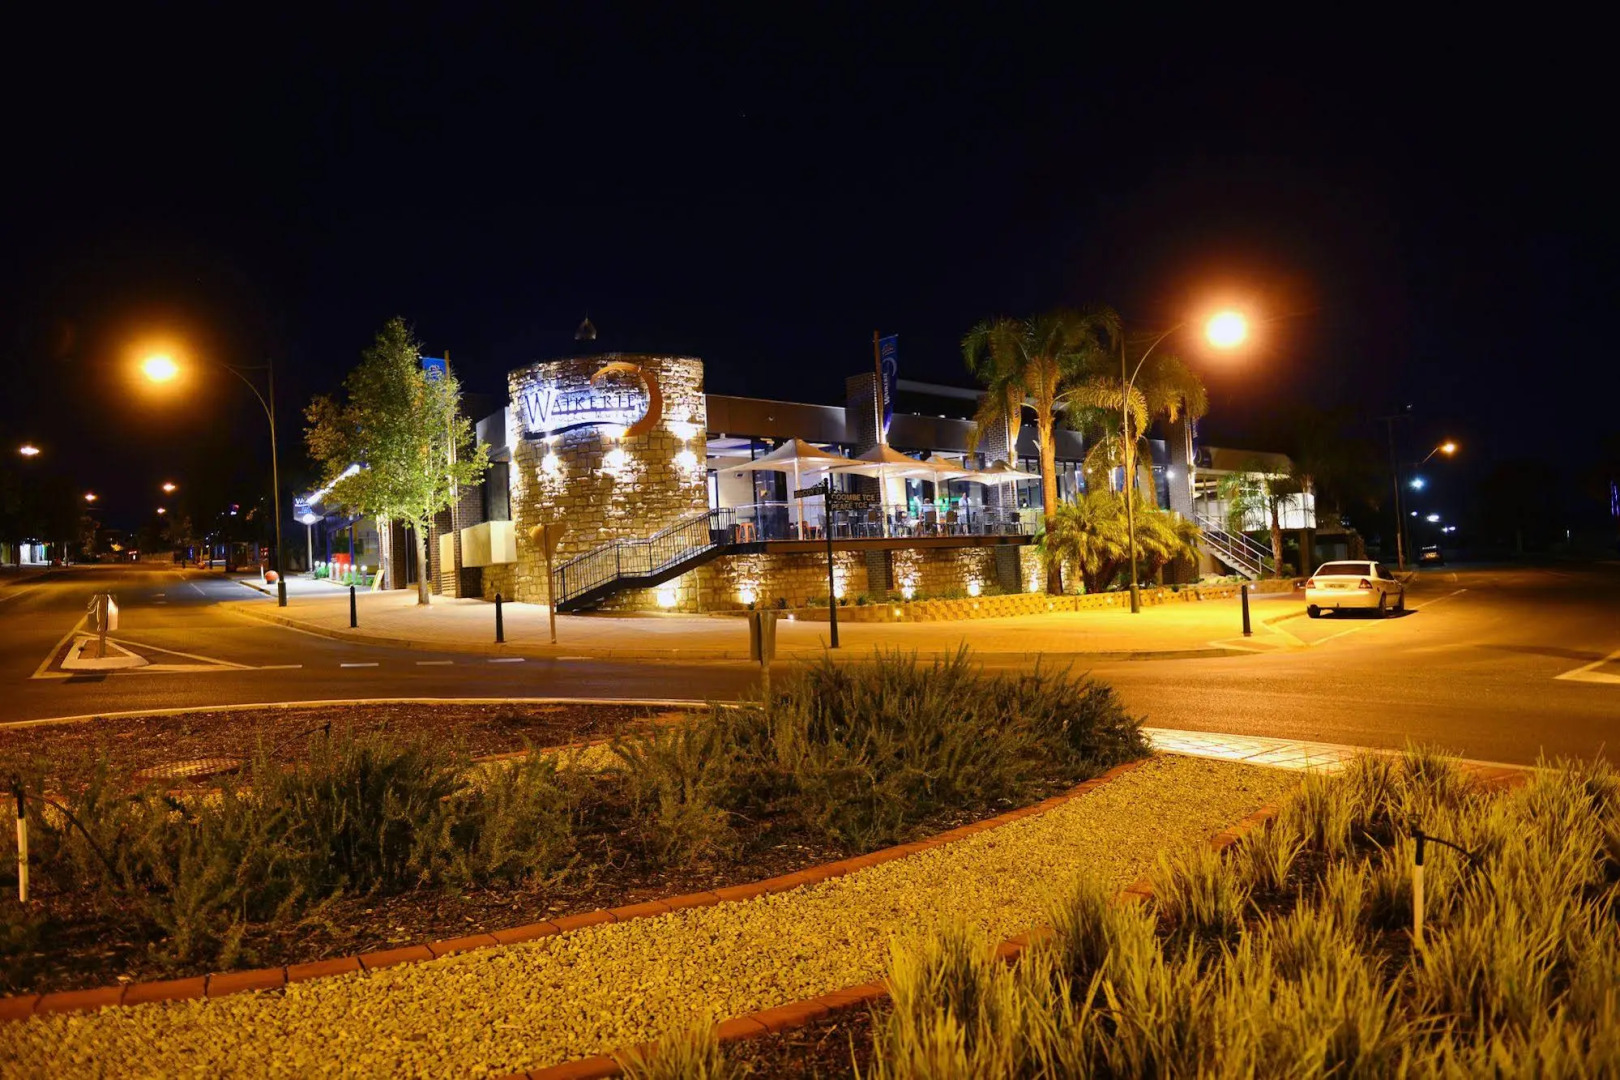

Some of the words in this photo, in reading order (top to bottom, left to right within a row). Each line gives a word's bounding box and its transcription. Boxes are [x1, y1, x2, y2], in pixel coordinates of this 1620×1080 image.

[524, 390, 635, 424] WAIKERIE
[831, 493, 861, 501] COOMBE
[831, 502, 853, 511] PEAKE
[854, 501, 868, 509] TCE
